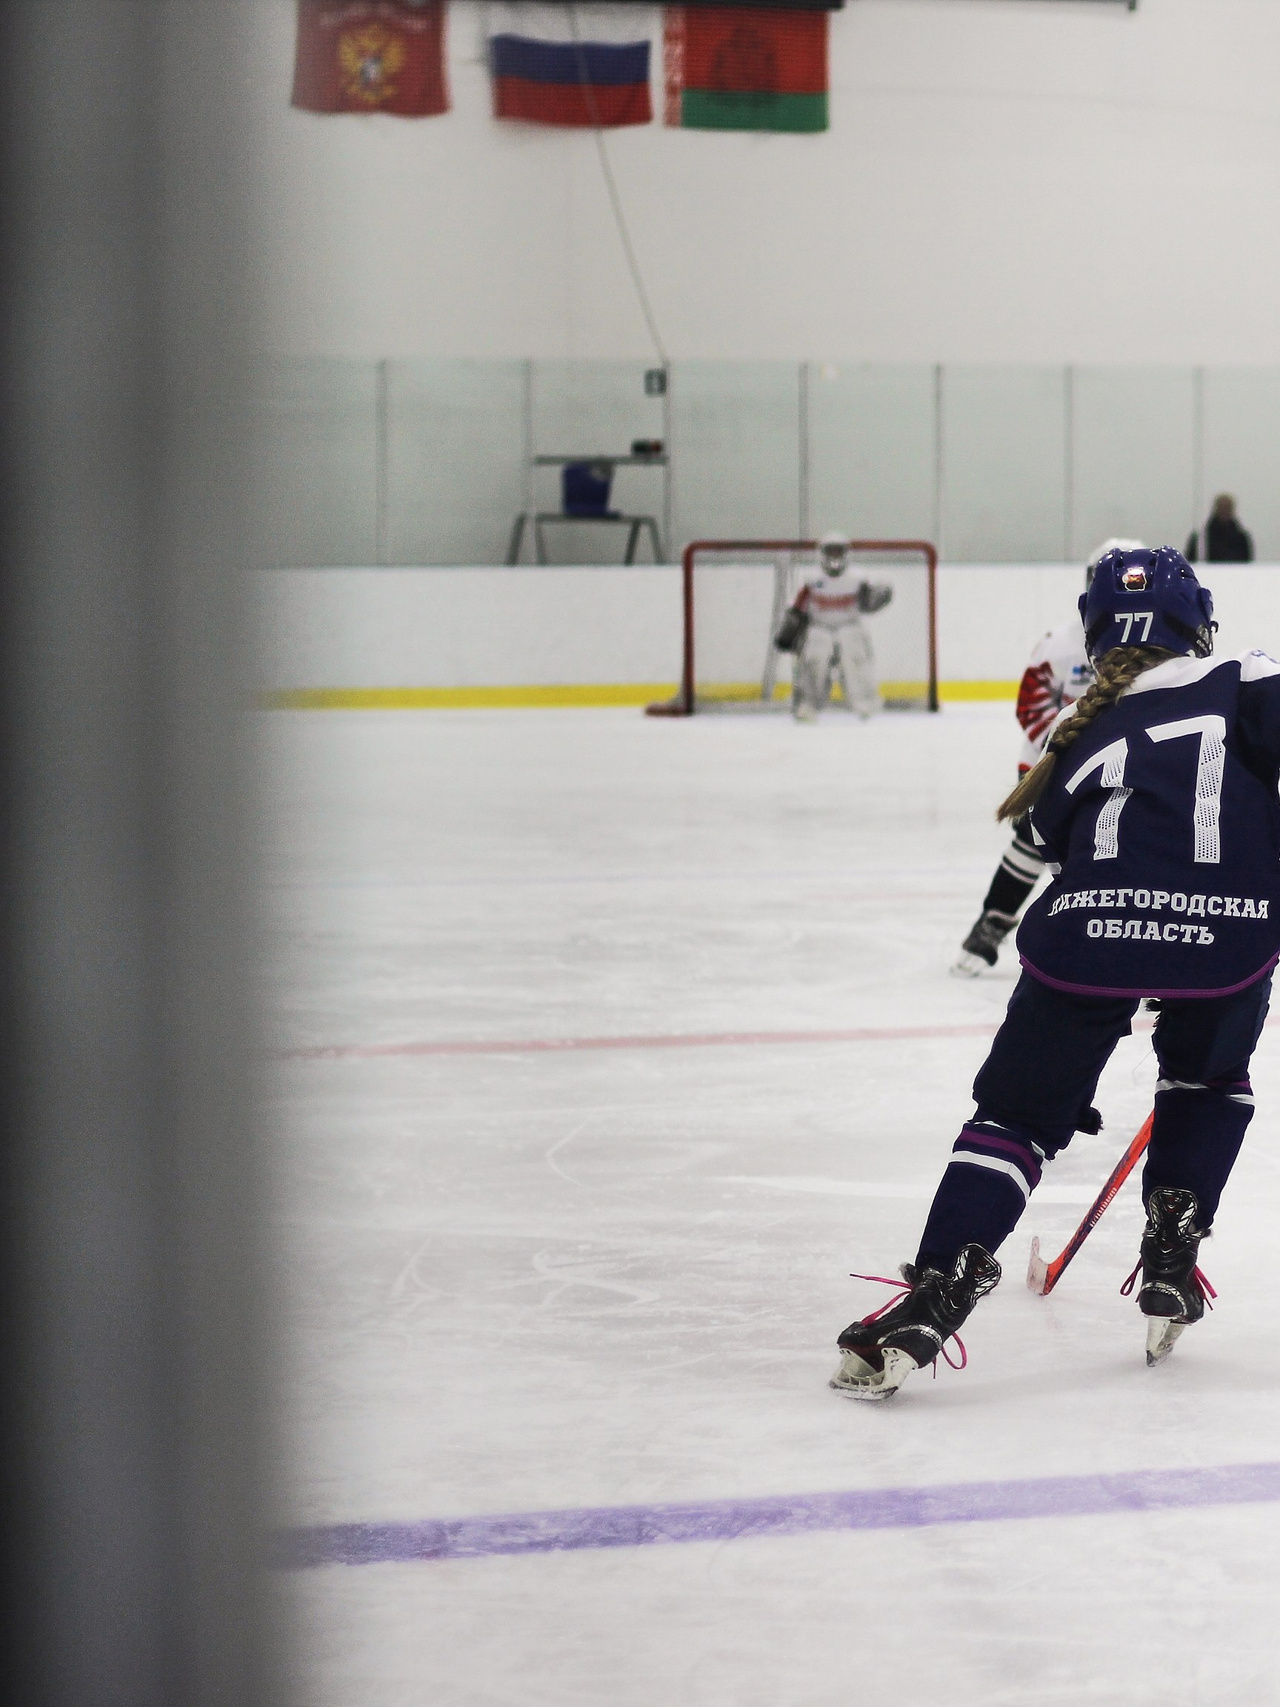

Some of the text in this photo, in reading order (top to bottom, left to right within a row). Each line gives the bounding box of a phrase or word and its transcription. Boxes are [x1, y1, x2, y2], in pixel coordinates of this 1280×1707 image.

[1114, 611, 1154, 643] 77
[1064, 714, 1227, 864] 77
[1046, 888, 1270, 919] НИЖЕГОРОДСКАЯ
[1086, 918, 1215, 945] ОБЛАСТЬ
